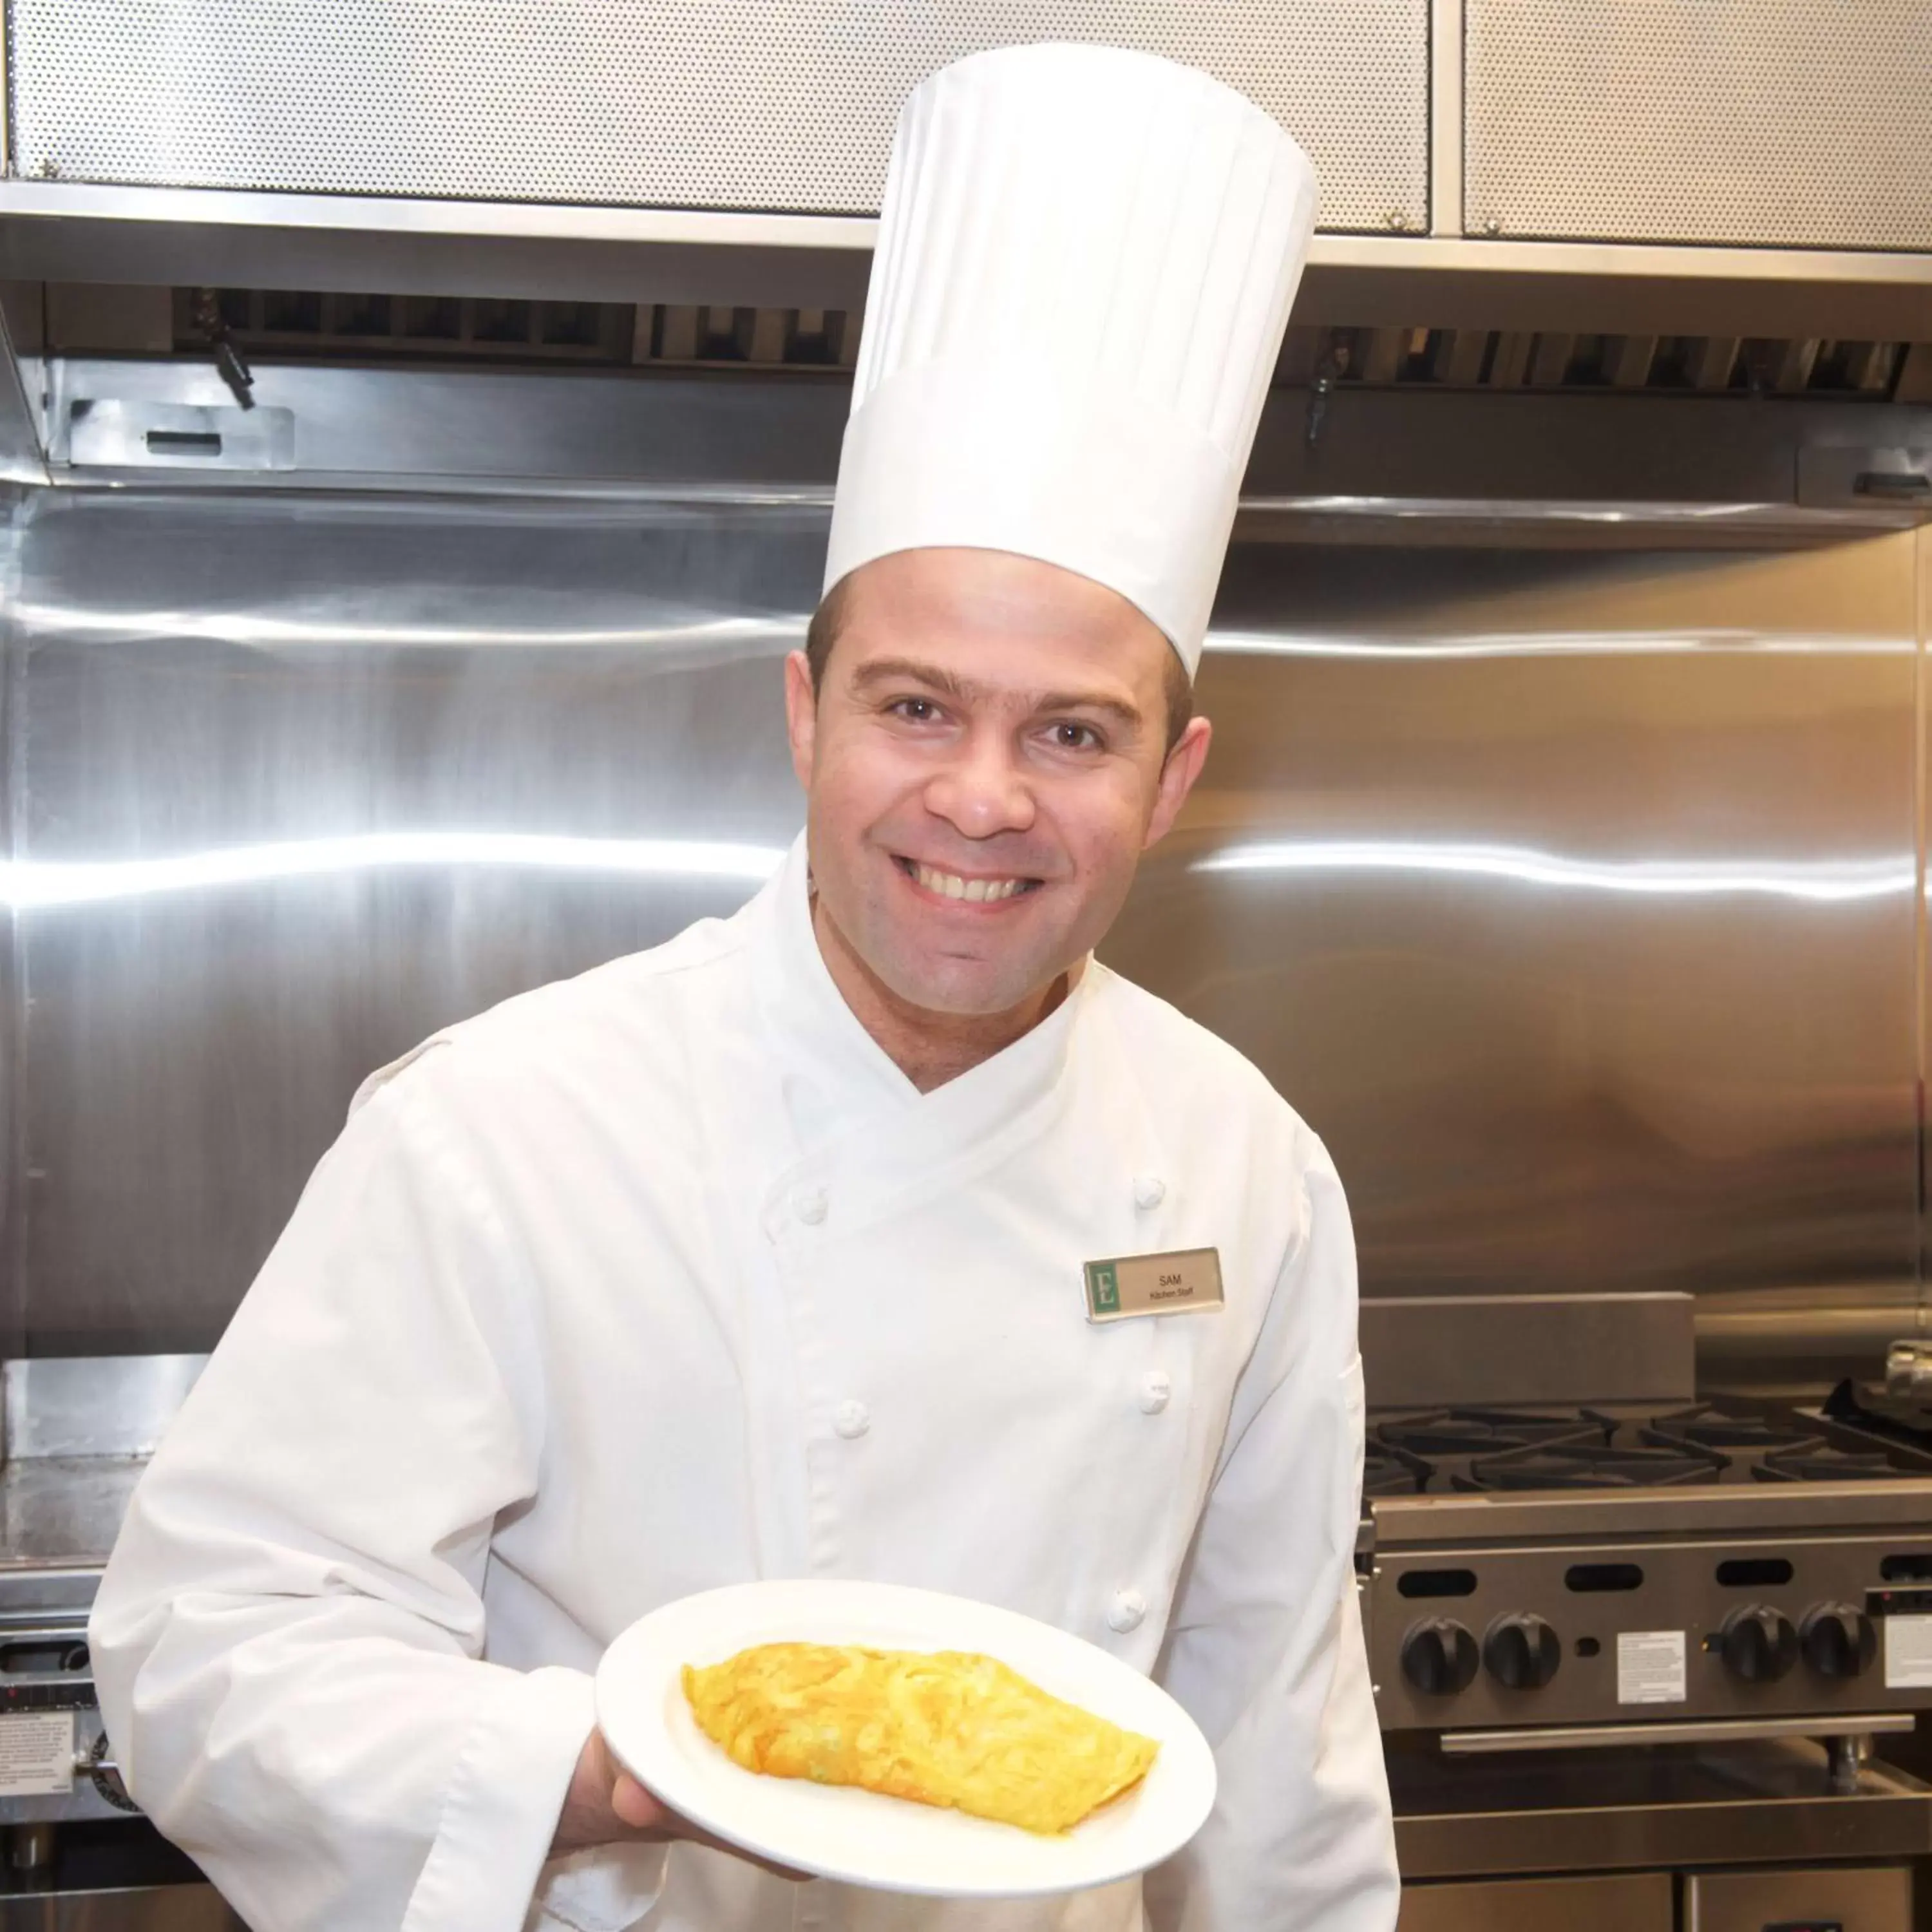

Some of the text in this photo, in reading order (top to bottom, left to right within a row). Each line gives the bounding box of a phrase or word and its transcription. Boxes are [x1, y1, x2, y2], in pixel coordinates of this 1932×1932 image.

[1159, 1274, 1182, 1287] SAM
[1150, 1287, 1193, 1300] Kitchen Staff
